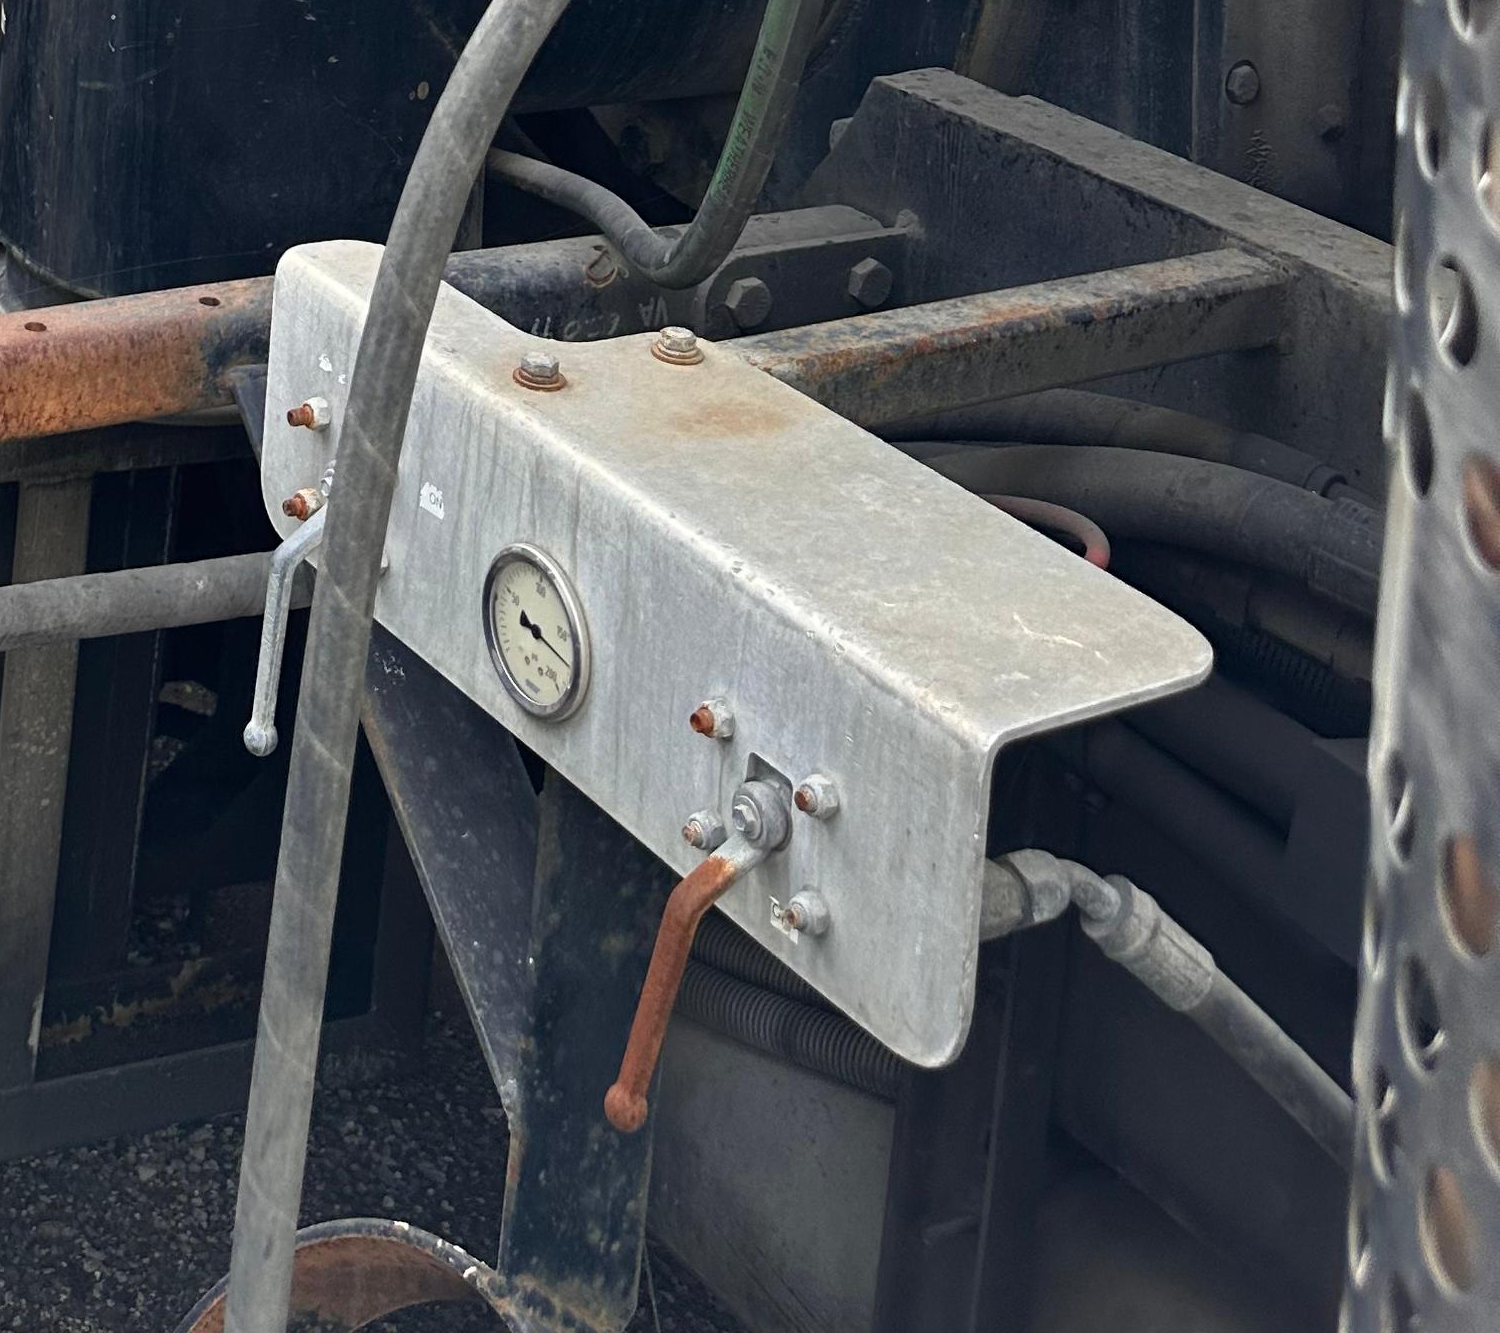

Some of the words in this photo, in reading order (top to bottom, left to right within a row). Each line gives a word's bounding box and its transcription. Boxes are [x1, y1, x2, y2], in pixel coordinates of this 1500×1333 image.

[511, 593, 520, 607] 50
[556, 624, 568, 642] 150
[545, 665, 558, 682] 200
